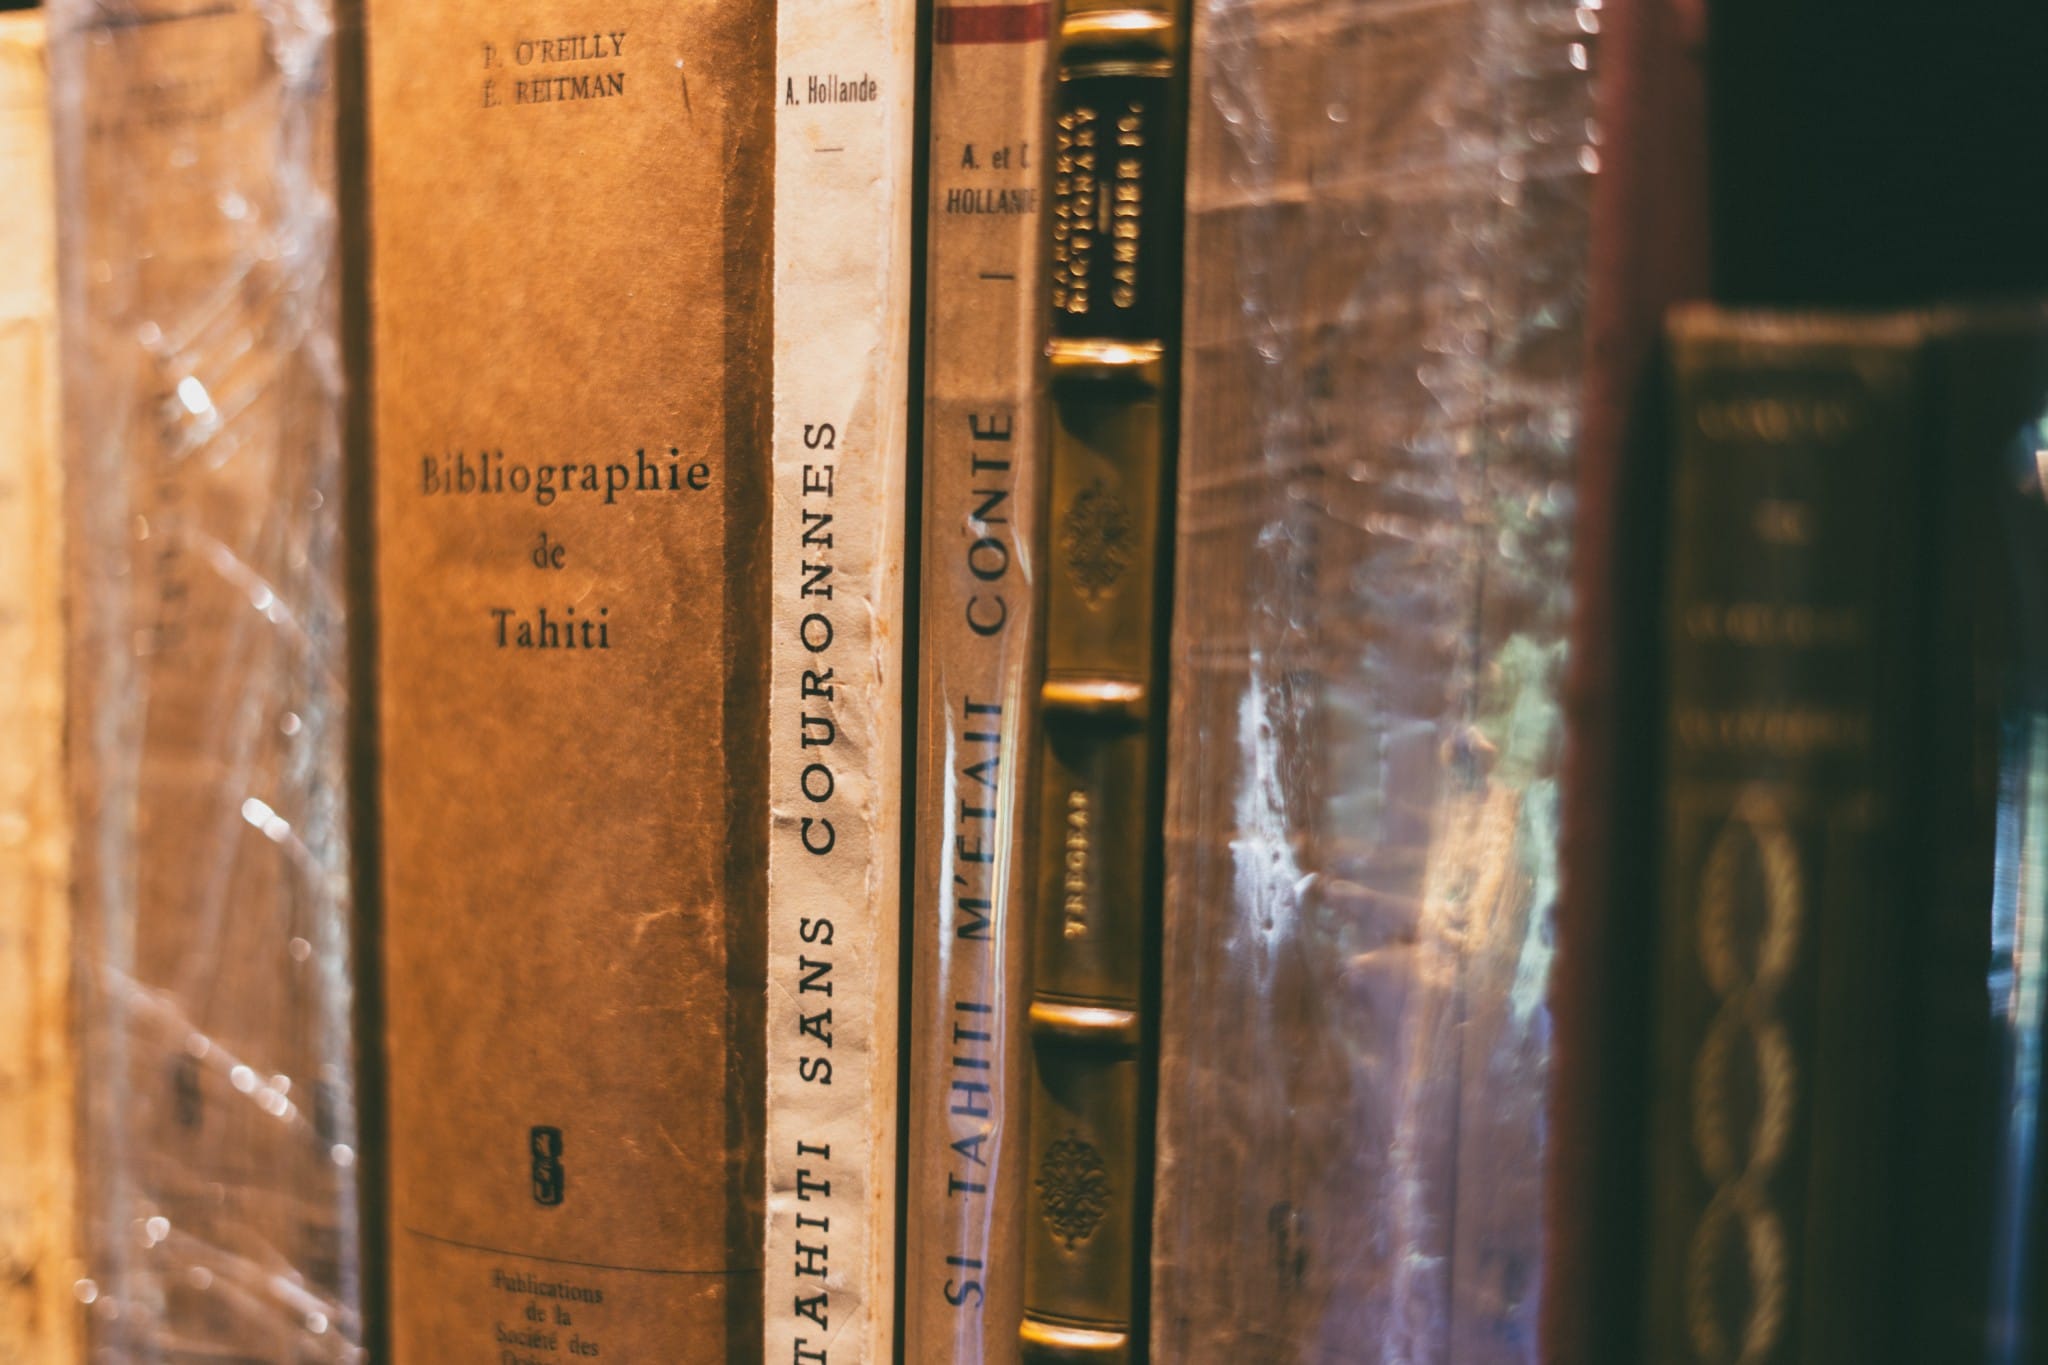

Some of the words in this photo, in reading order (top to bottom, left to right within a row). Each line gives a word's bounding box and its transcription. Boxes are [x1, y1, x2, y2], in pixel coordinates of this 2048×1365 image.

[516, 32, 626, 66] O'REILLY
[516, 73, 626, 105] REITMAN
[785, 76, 800, 106] A.
[808, 72, 878, 104] Hollande
[961, 143, 981, 170] A.
[991, 146, 1011, 170] et
[421, 447, 712, 506] Bibliographie
[532, 531, 566, 570] de
[490, 607, 612, 650] Tahiti
[800, 422, 837, 856] COURONNES
[799, 917, 834, 1085] SANS
[947, 1001, 993, 1198] TAHITI
[794, 1140, 832, 1365] TAHITI
[489, 1267, 604, 1304] Publications
[943, 1259, 985, 1308] SI
[524, 1301, 547, 1323] de
[554, 1303, 573, 1326] la
[568, 1332, 600, 1357] des
